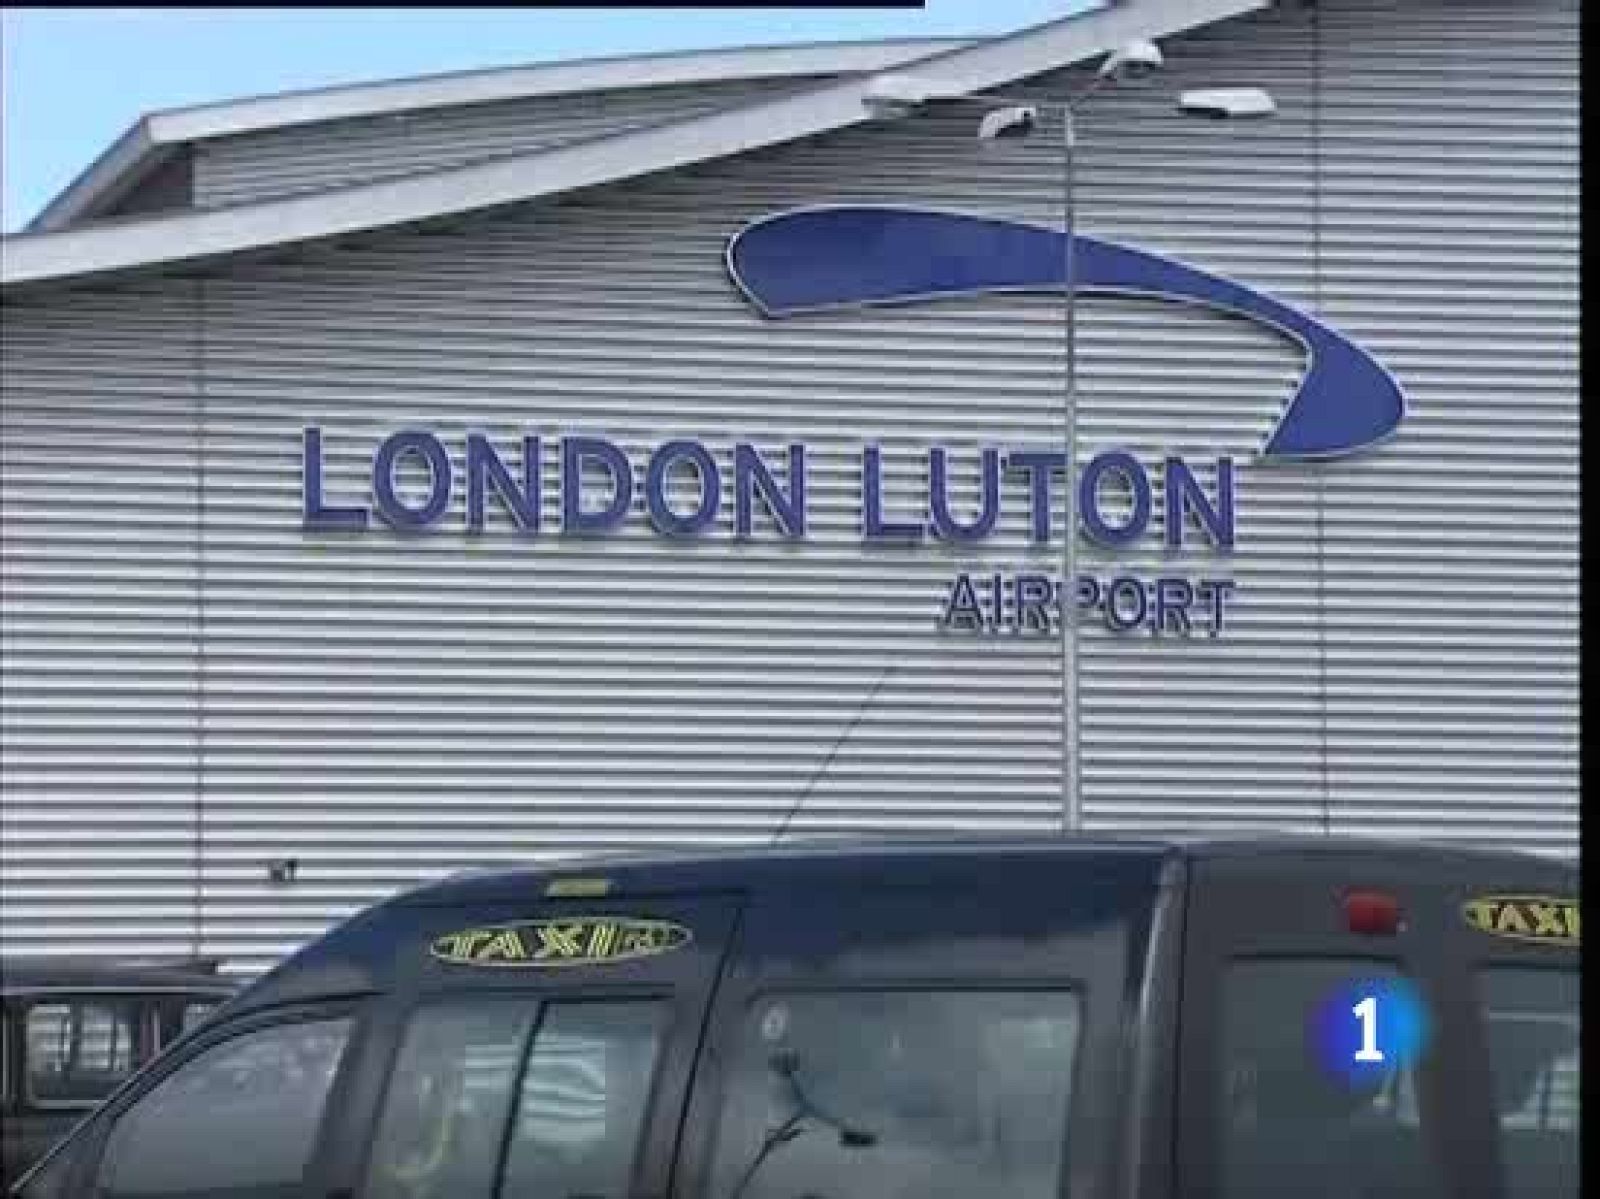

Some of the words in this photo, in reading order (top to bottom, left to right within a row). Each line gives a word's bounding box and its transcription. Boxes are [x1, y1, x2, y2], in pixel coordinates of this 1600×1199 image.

[302, 427, 806, 538] LONDON
[862, 447, 1235, 550] LUTON
[944, 573, 1235, 637] AIRPORT
